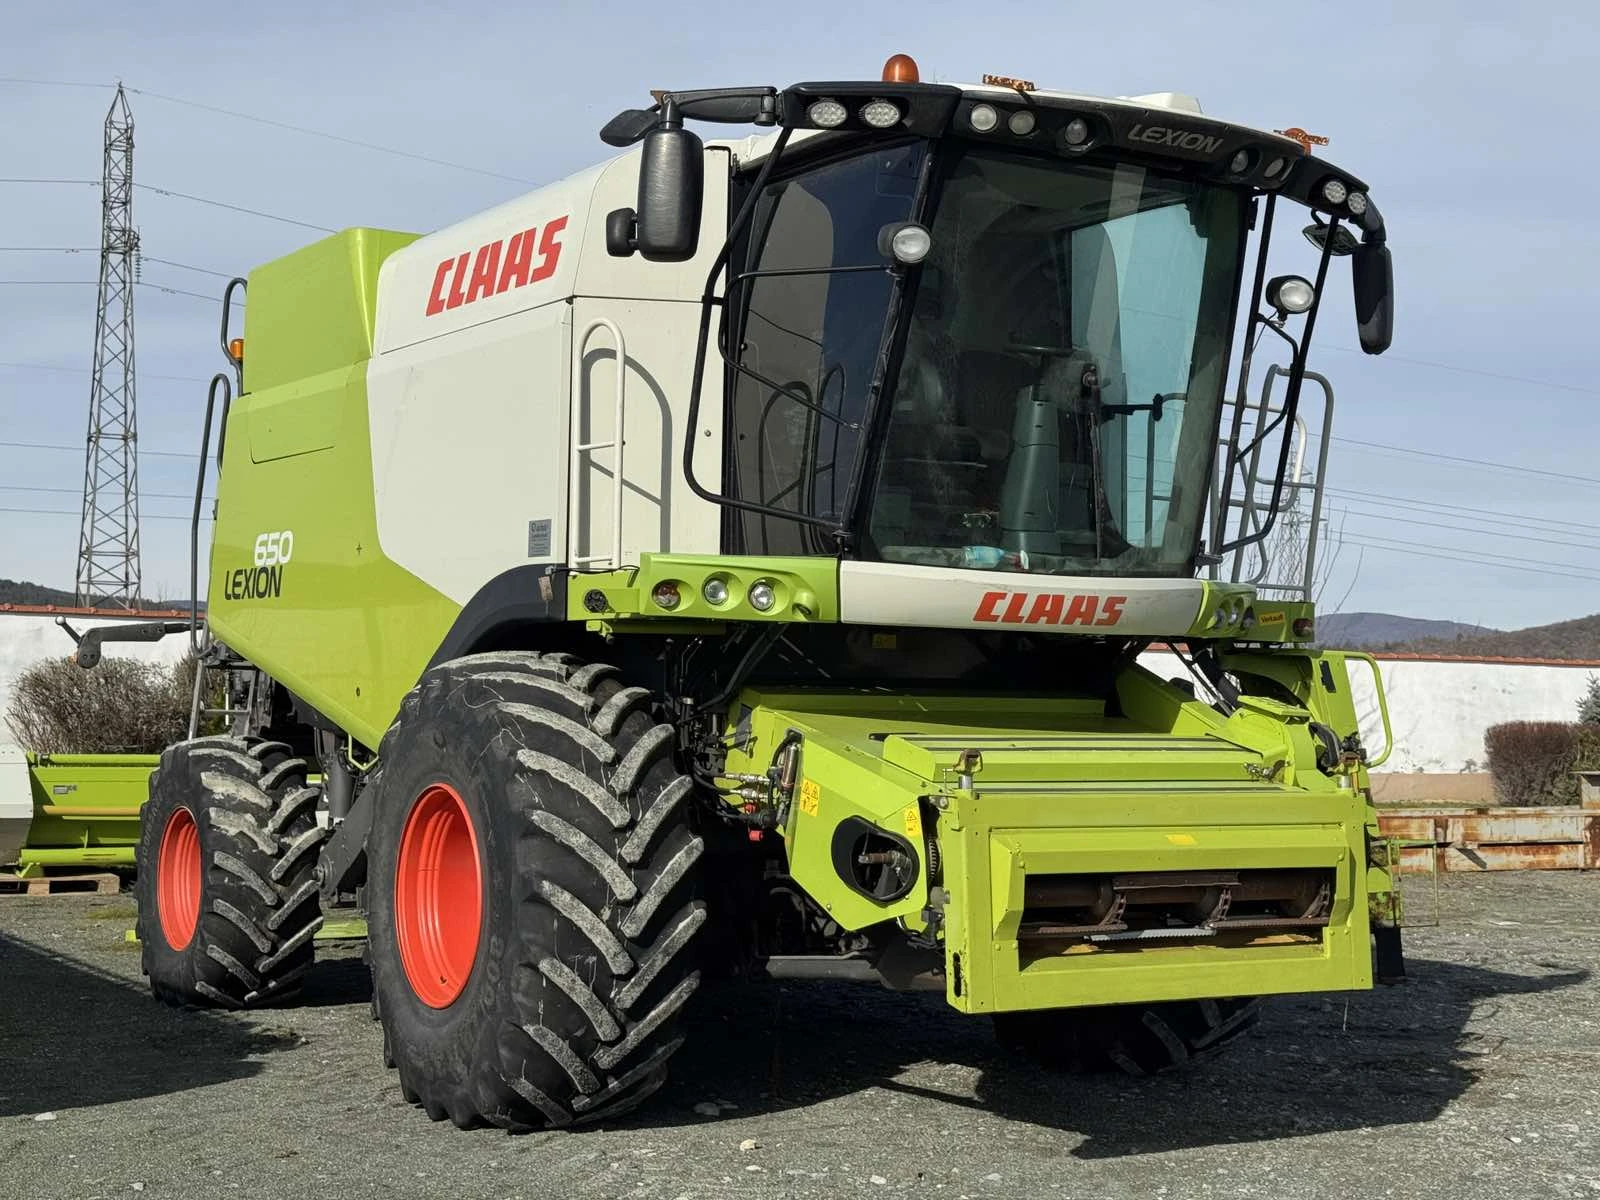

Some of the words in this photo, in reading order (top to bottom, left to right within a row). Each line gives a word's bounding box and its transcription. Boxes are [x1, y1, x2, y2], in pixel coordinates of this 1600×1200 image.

[1128, 124, 1224, 153] LEXION
[426, 215, 569, 317] CLAAS
[255, 530, 294, 566] 650
[225, 565, 283, 600] LEXION
[973, 592, 1128, 626] CLAAS
